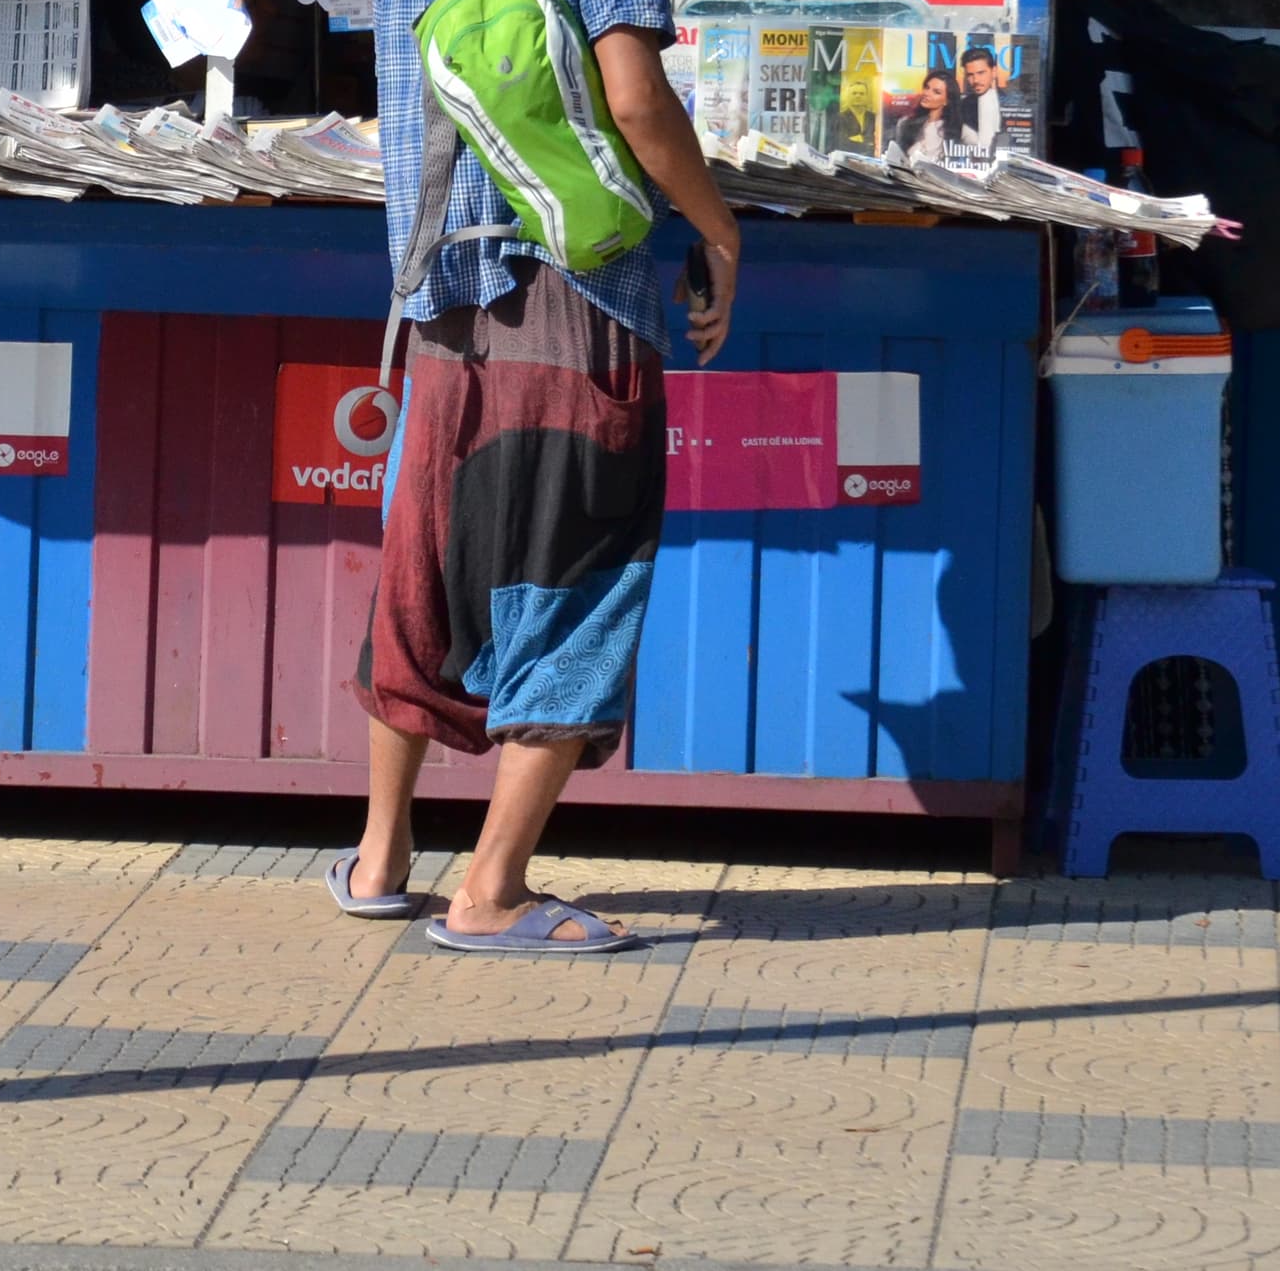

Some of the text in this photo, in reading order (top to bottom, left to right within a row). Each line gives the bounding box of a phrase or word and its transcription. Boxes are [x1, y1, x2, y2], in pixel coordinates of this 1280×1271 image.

[812, 39, 883, 73] MA
[17, 447, 59, 467] eagle
[291, 461, 384, 492] vodaf
[869, 478, 912, 497] eagle
